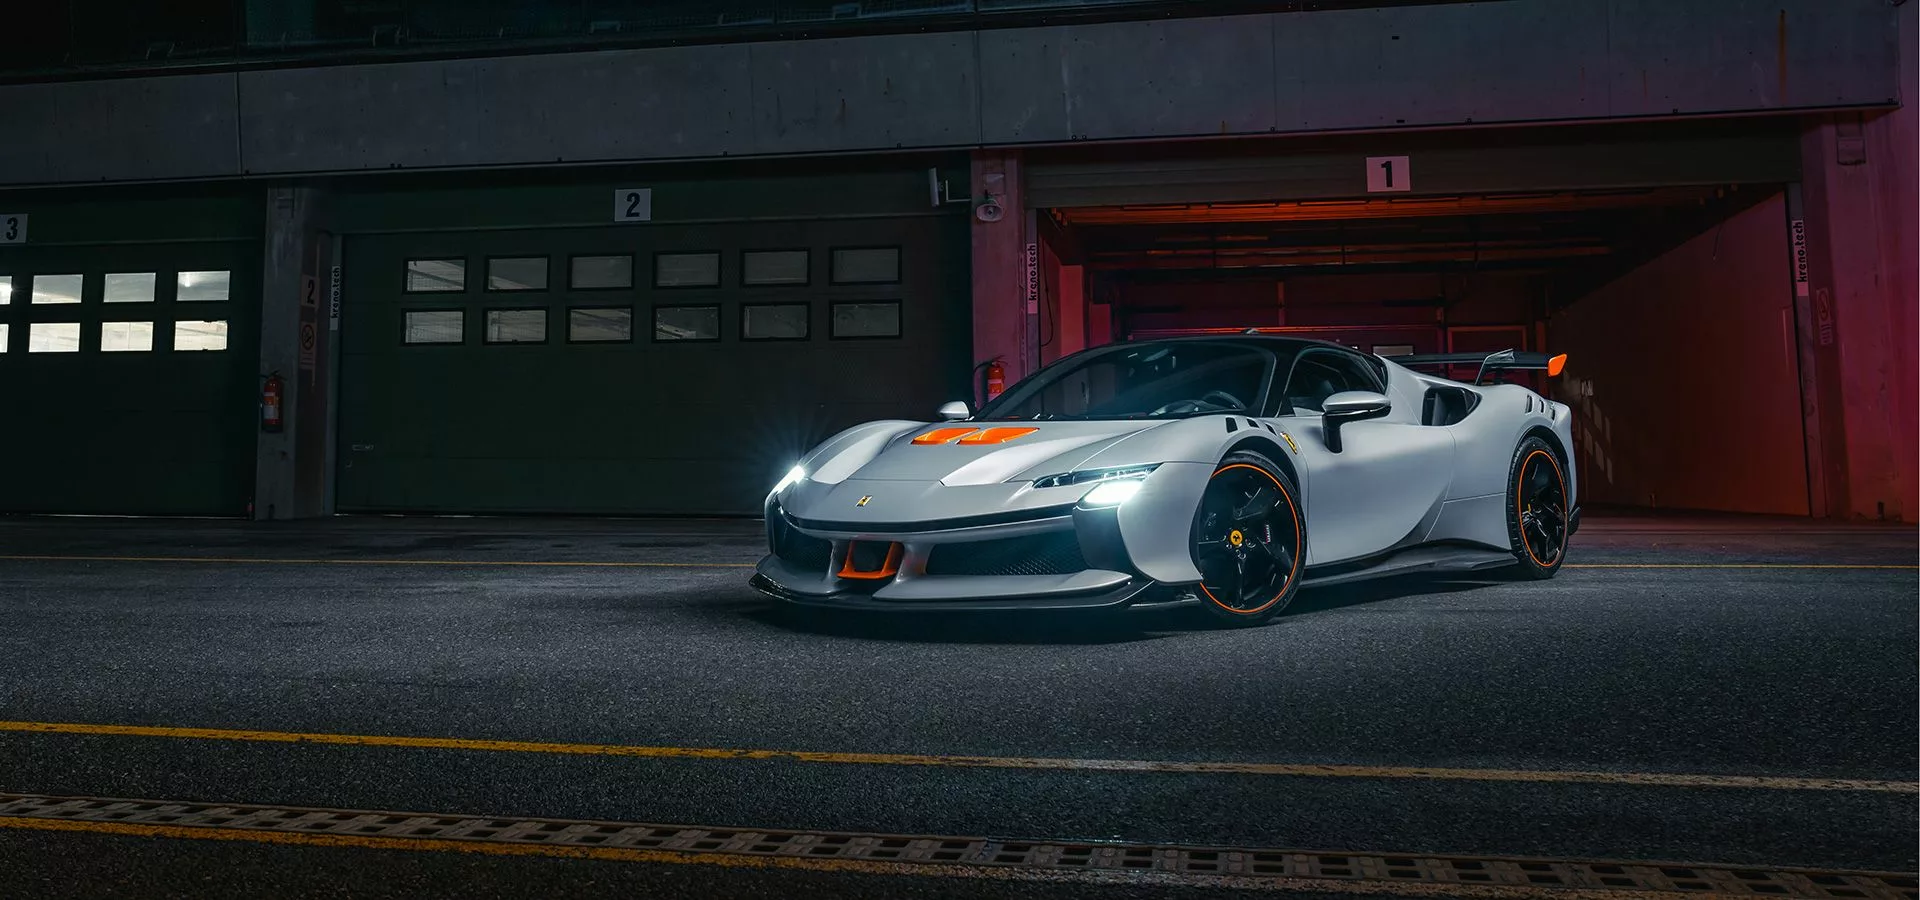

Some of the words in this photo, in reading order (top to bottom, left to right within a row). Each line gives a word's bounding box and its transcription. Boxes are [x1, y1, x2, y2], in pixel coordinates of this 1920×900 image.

[1381, 161, 1392, 188] 1
[625, 192, 640, 218] 2
[6, 217, 18, 240] 3
[1793, 222, 1807, 283] kreno.tech
[1027, 245, 1037, 301] kreno.tech
[307, 279, 315, 304] 2
